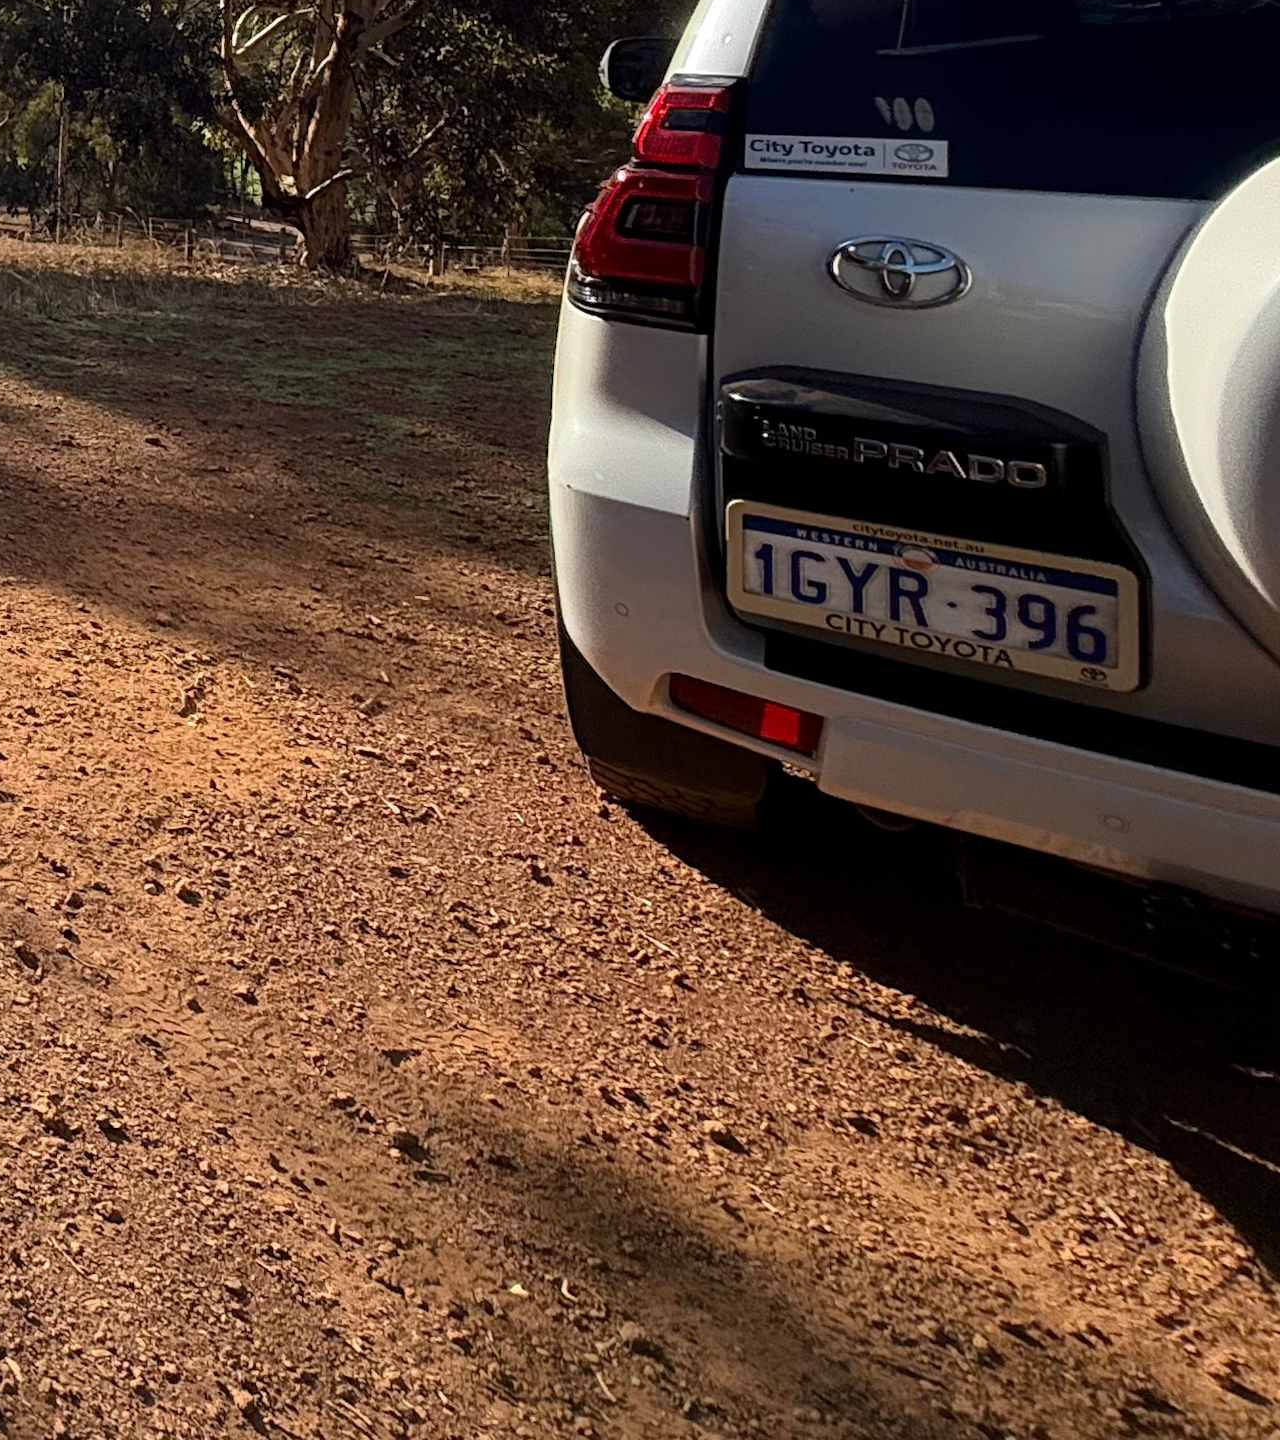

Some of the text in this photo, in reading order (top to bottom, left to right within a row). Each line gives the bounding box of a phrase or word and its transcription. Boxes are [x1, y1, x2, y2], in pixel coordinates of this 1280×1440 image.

[749, 138, 876, 159] City Toyota
[762, 419, 817, 441] LAND
[763, 434, 849, 460] CRUISER
[853, 436, 1048, 489] PRADO
[796, 527, 1048, 583] WESTERN AUSTRALIA
[851, 522, 986, 555] citytoyota.net.au
[825, 613, 1016, 669] CITY TOYOTA
